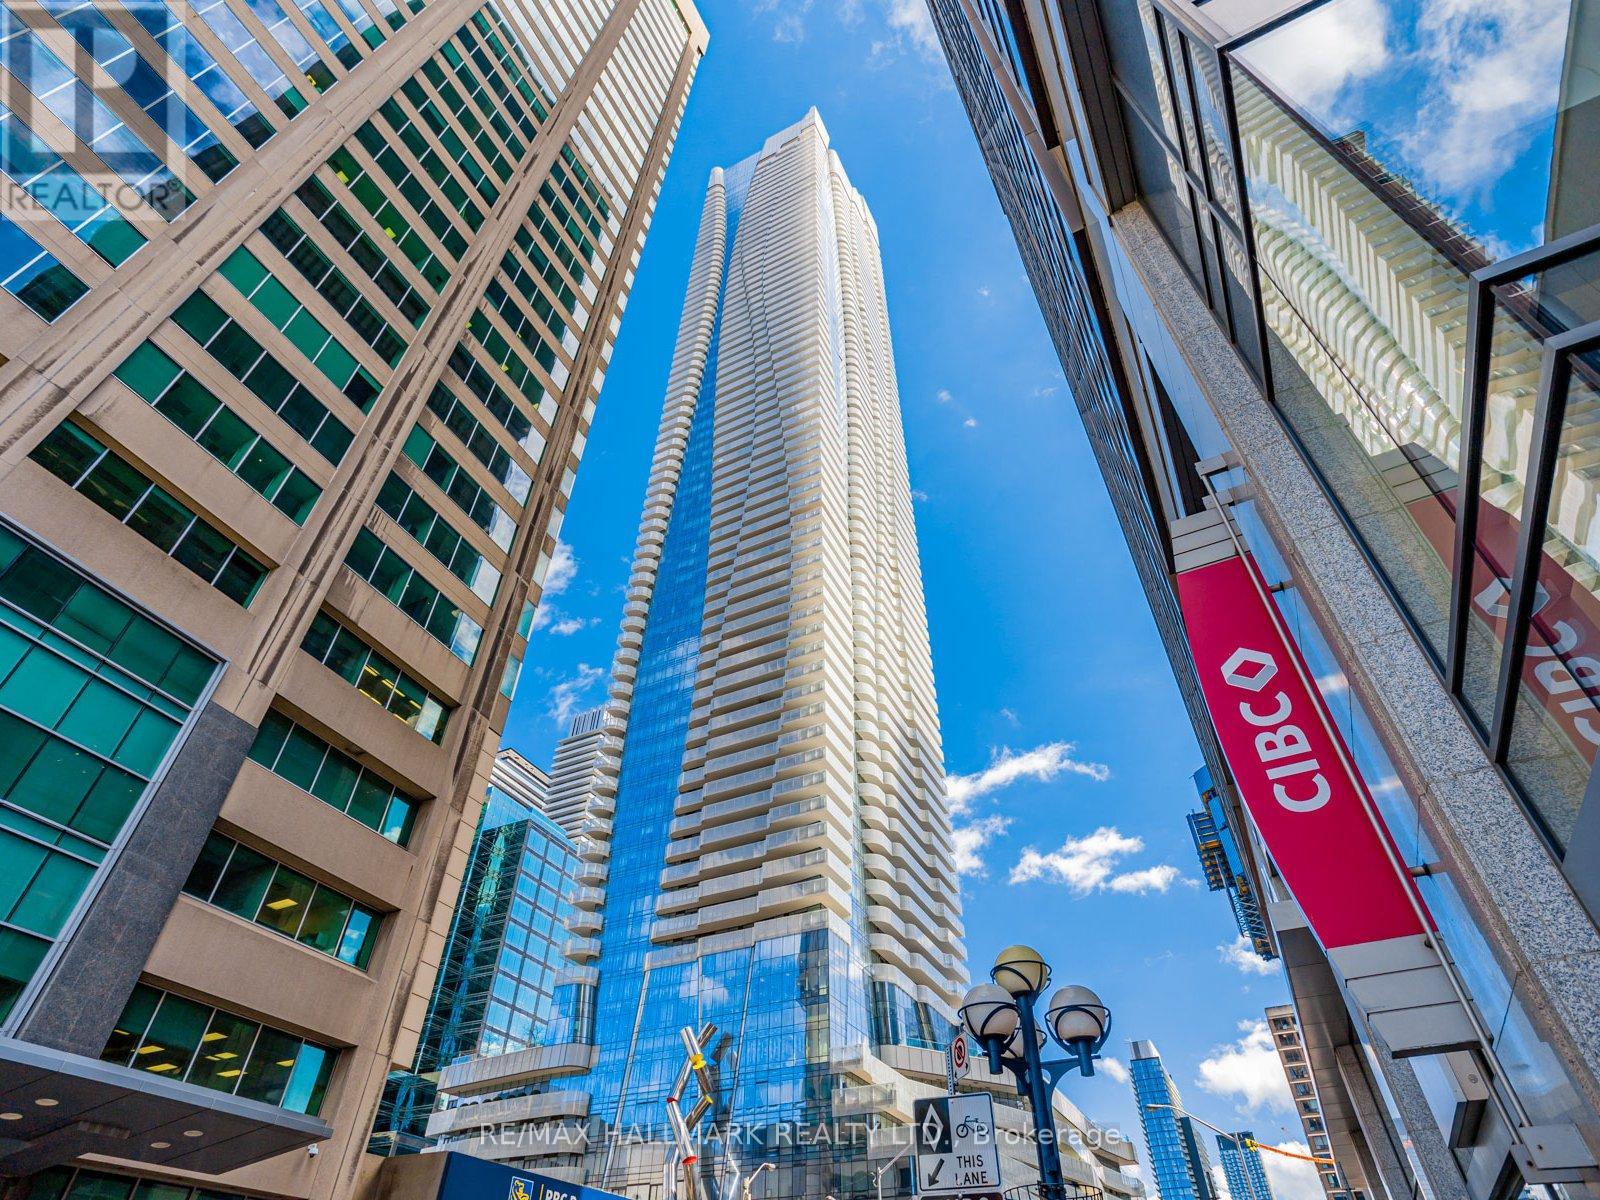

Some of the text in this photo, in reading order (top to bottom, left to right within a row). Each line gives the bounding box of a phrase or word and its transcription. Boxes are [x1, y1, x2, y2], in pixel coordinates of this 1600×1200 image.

[1239, 691, 1332, 813] CIBC
[956, 1154, 984, 1169] THIS
[955, 1171, 989, 1186] LANE
